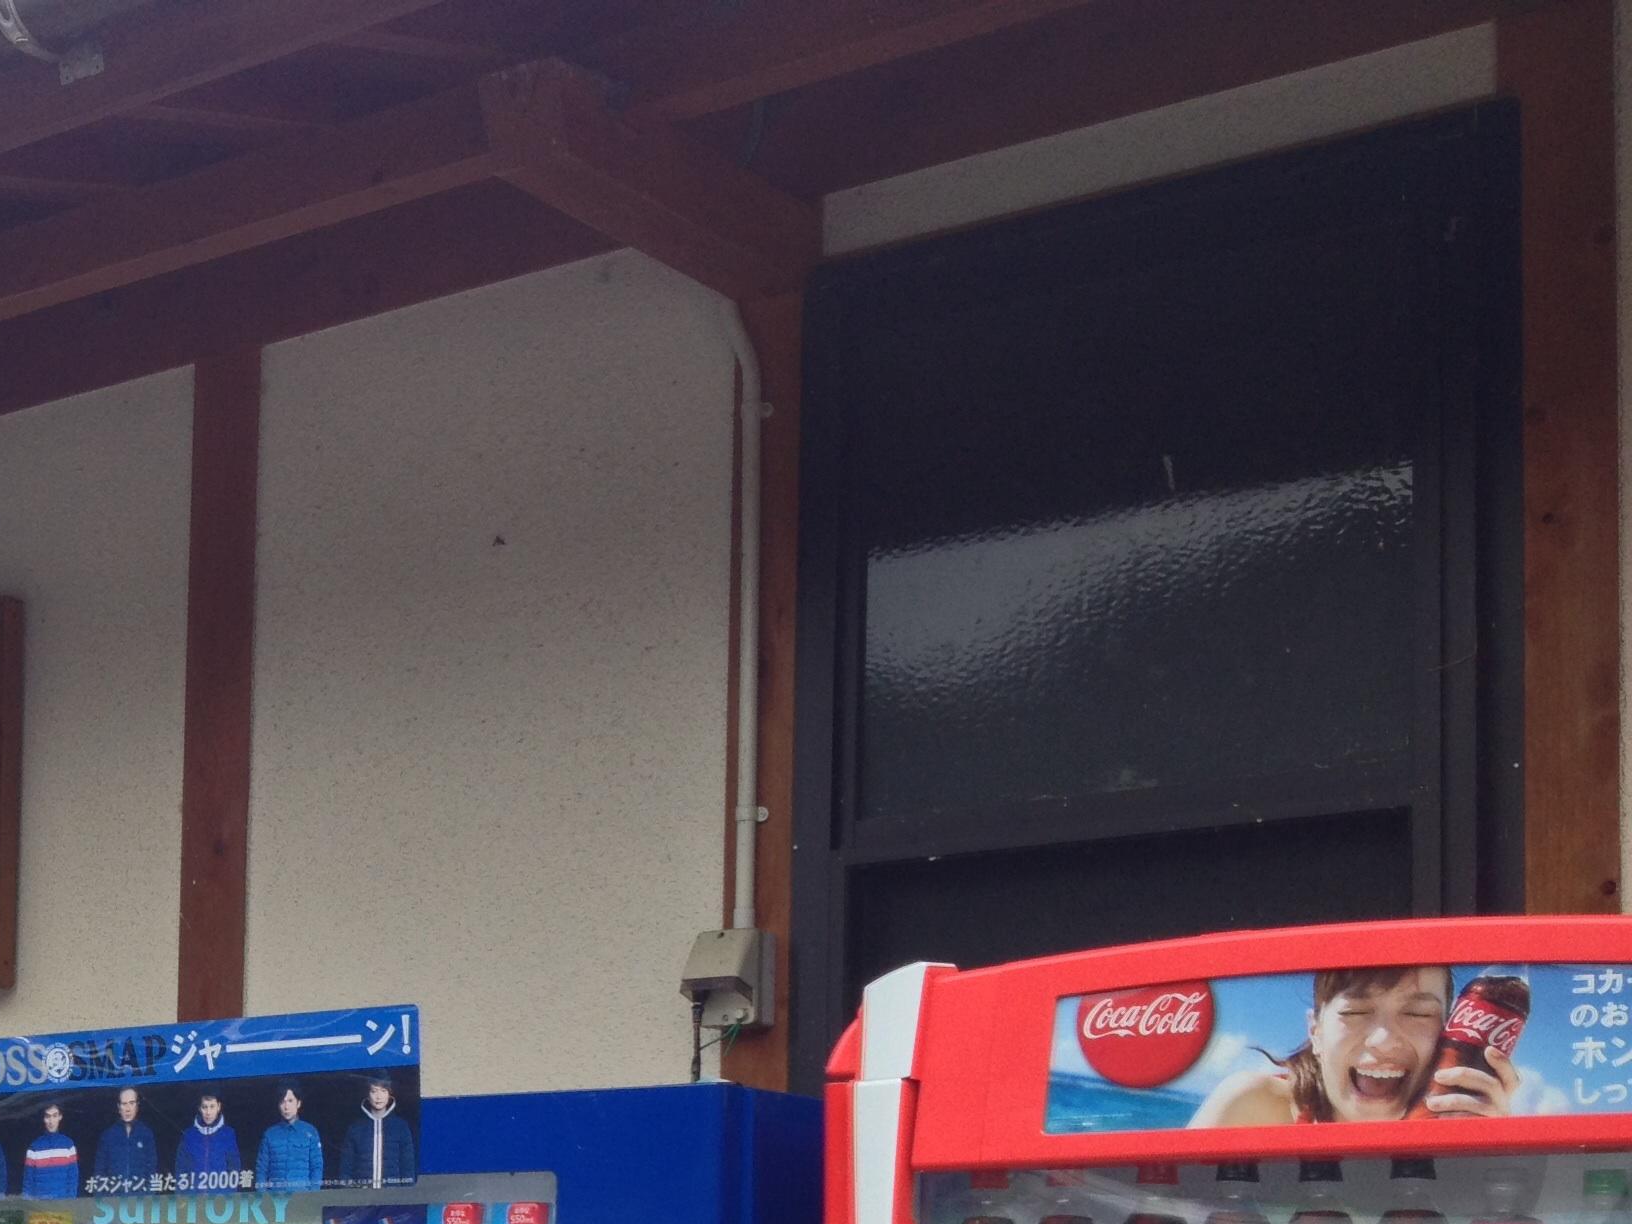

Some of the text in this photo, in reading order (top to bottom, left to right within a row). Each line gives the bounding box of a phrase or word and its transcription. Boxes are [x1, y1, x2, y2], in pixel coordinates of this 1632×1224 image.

[1571, 968, 1632, 994] コカ
[1082, 992, 1208, 1040] Coca-Cola
[69, 1033, 166, 1081] SMAP
